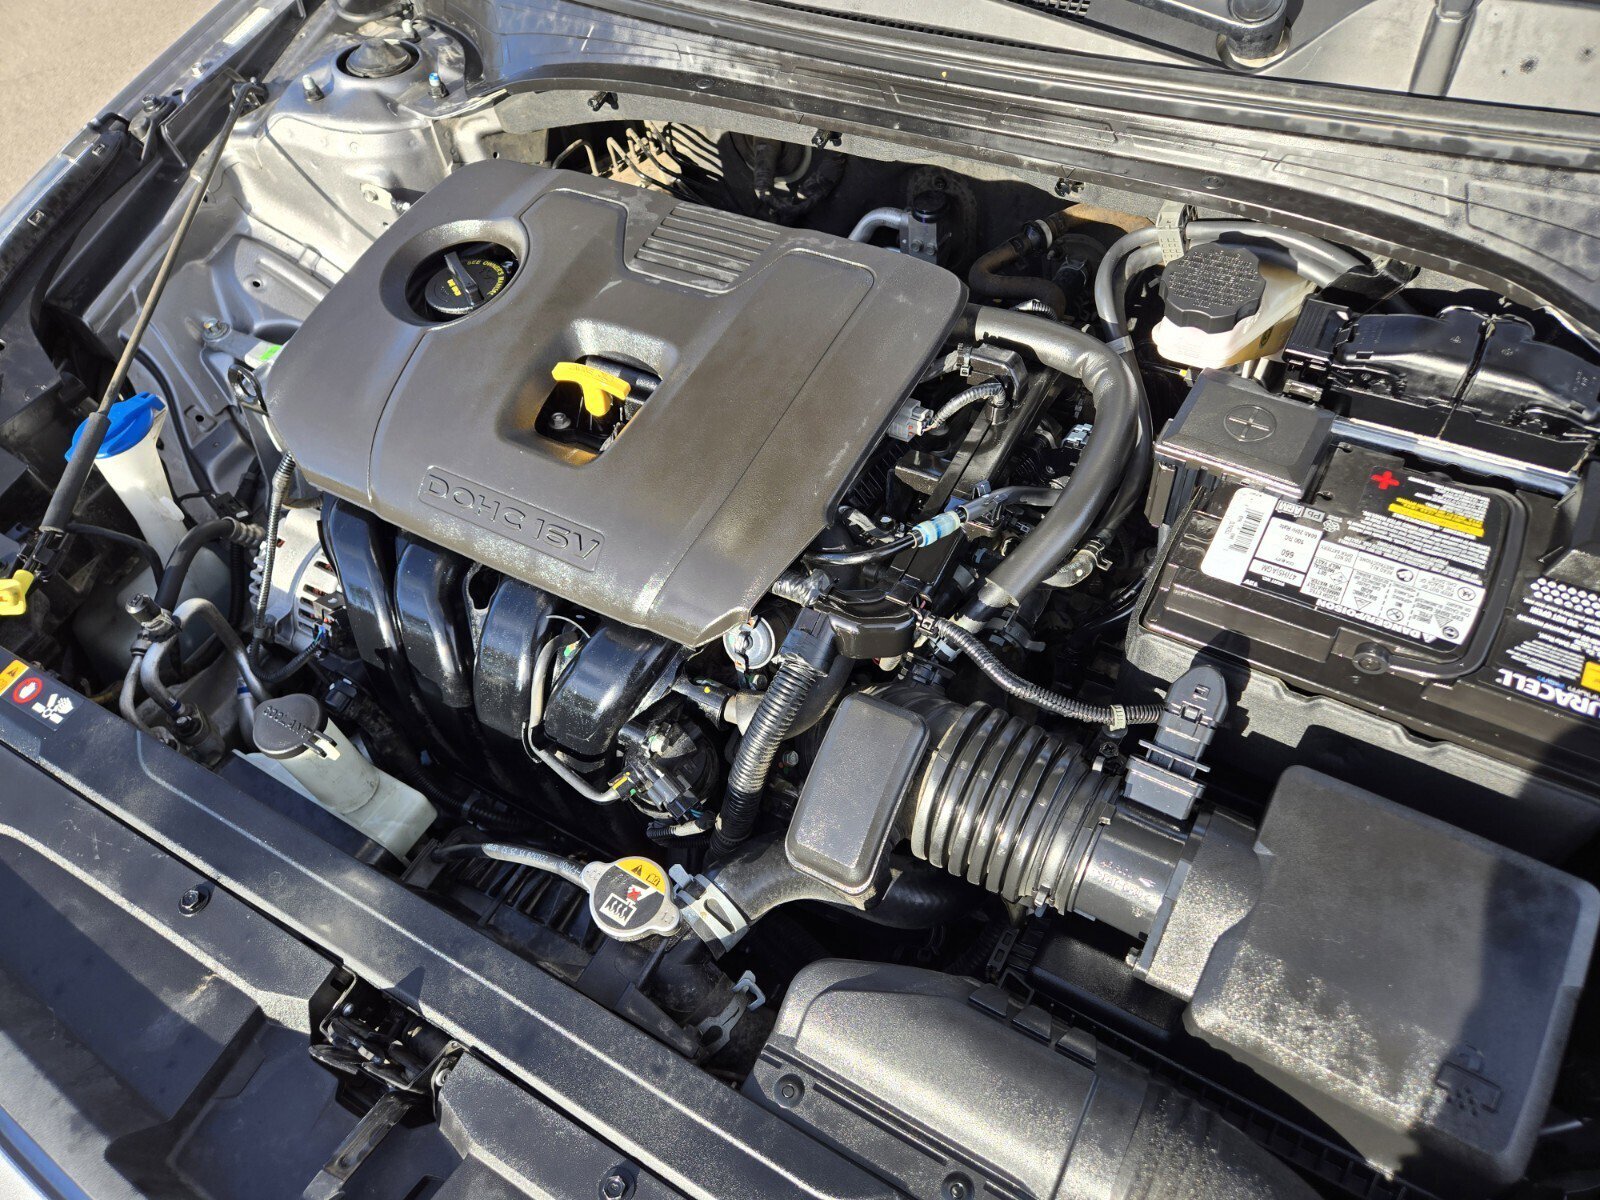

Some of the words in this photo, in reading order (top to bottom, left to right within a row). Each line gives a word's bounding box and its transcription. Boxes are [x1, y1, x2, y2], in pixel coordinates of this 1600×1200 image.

[428, 474, 526, 532] DOHC
[1307, 510, 1321, 519] Pb
[1280, 549, 1295, 559] 660
[1315, 599, 1422, 639] DANGER/POISON
